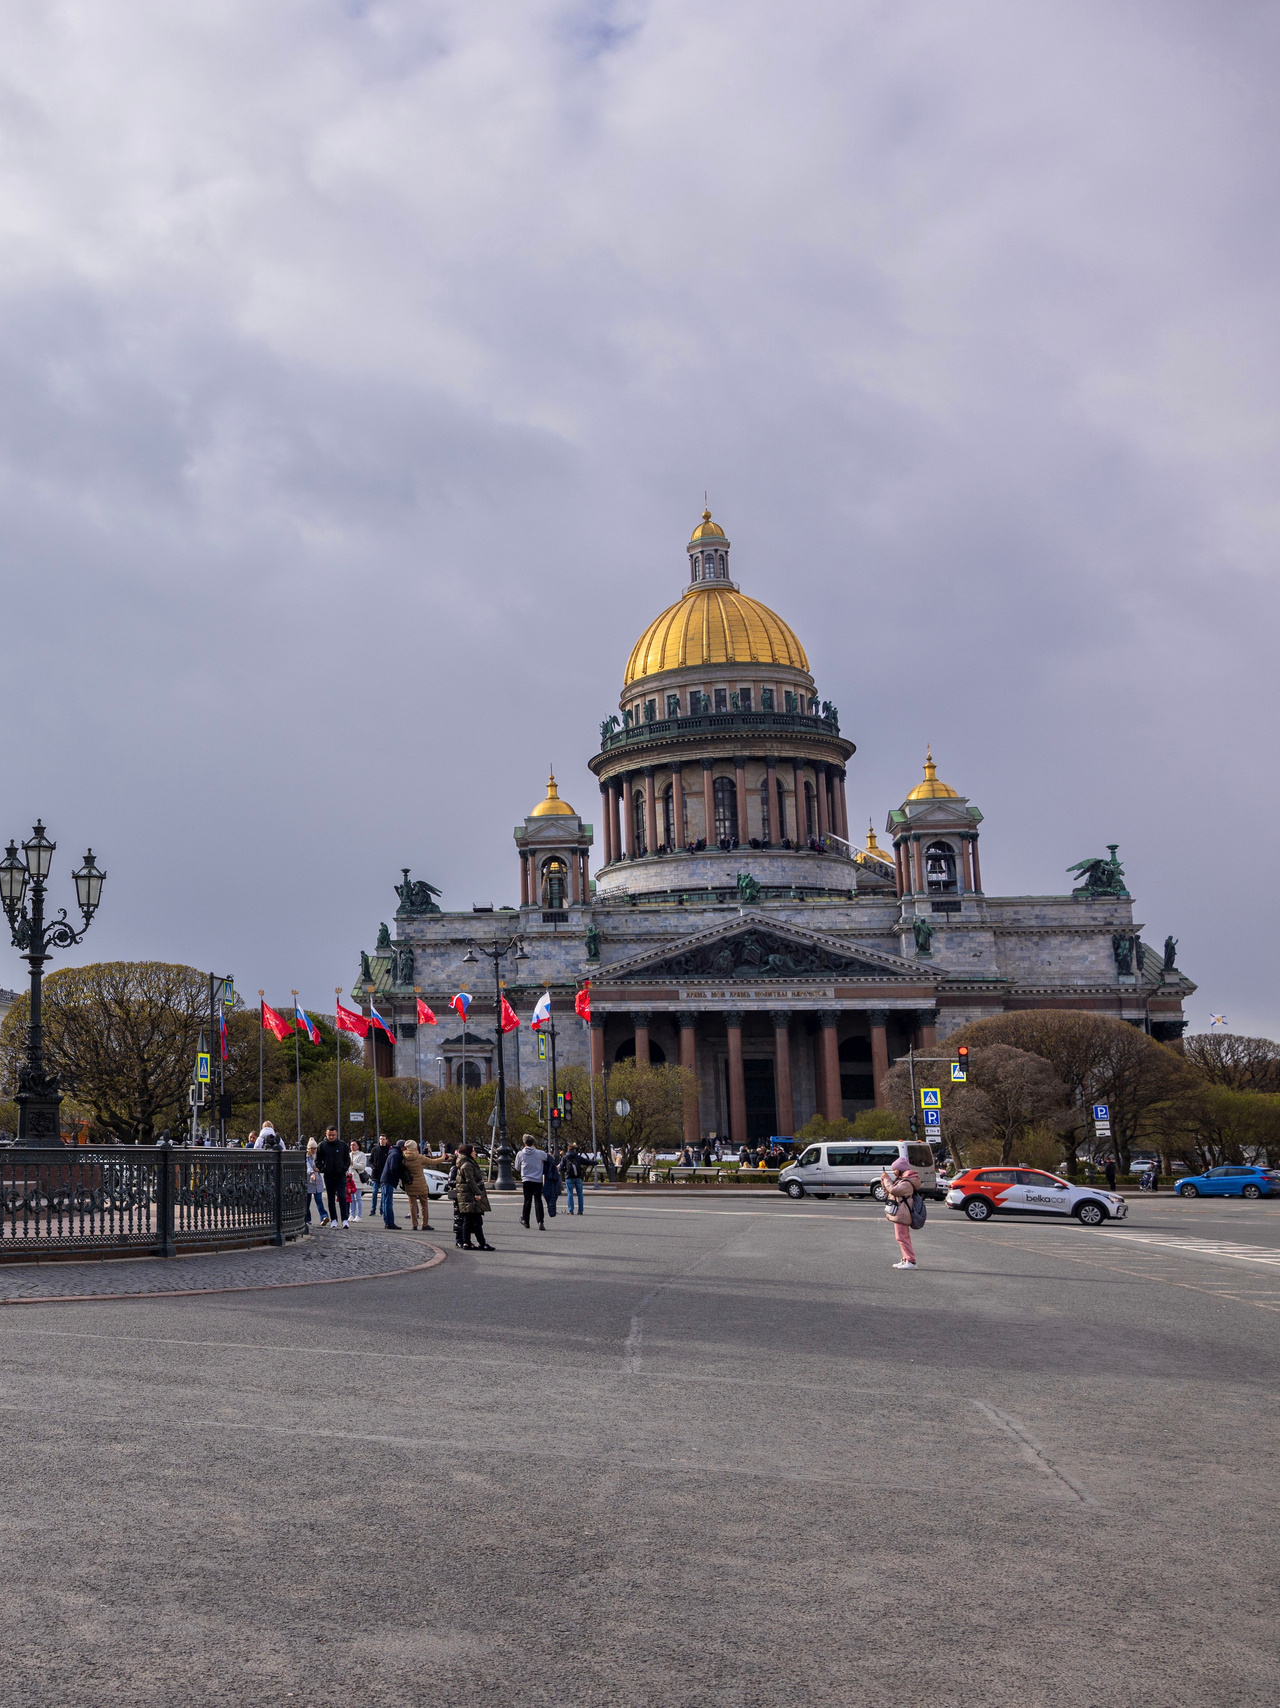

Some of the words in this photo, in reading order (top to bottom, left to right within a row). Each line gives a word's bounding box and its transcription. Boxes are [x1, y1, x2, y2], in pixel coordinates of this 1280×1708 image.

[928, 1111, 936, 1123] P
[1097, 1107, 1106, 1118] P
[1026, 1194, 1066, 1204] belkacar
